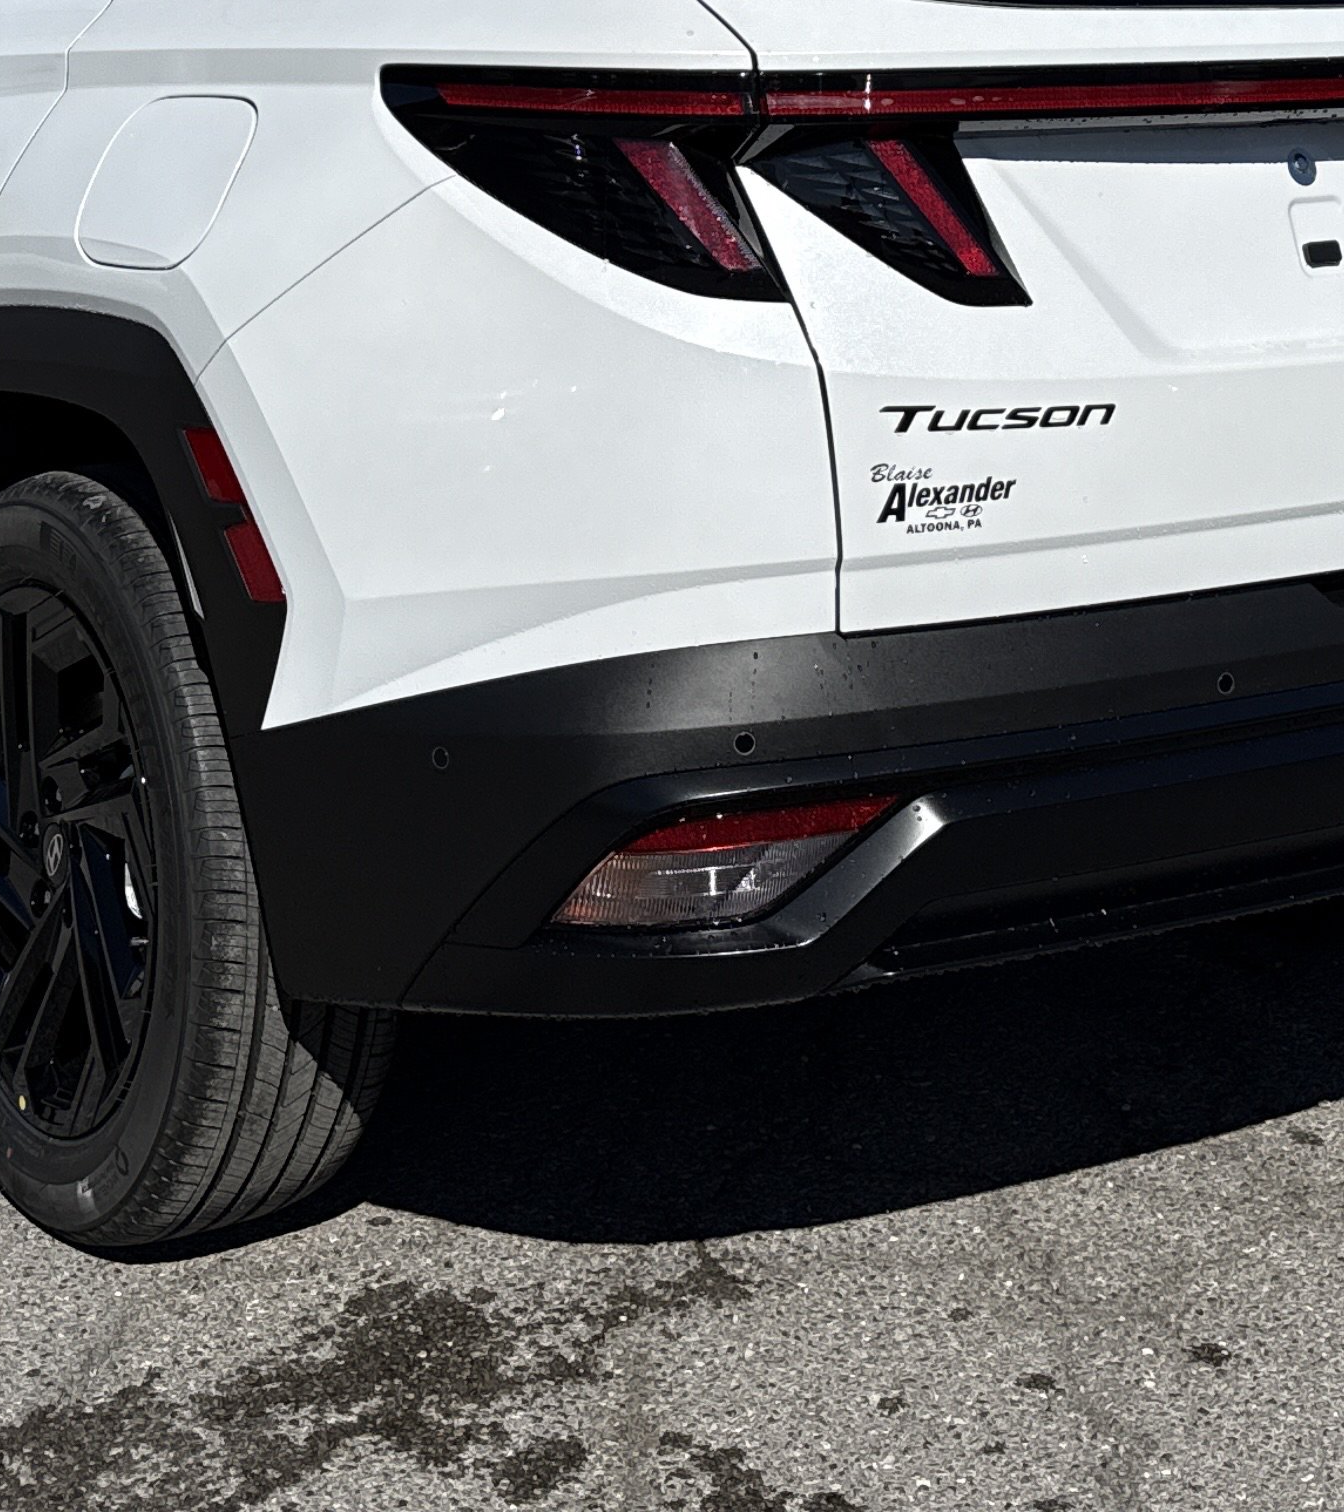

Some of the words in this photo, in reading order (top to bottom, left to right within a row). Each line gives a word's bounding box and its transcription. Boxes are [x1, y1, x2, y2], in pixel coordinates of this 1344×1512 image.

[870, 463, 933, 482] Blaise
[876, 476, 1017, 524] Alexander
[906, 520, 965, 534] ALTOONA,
[967, 518, 982, 529] PA
